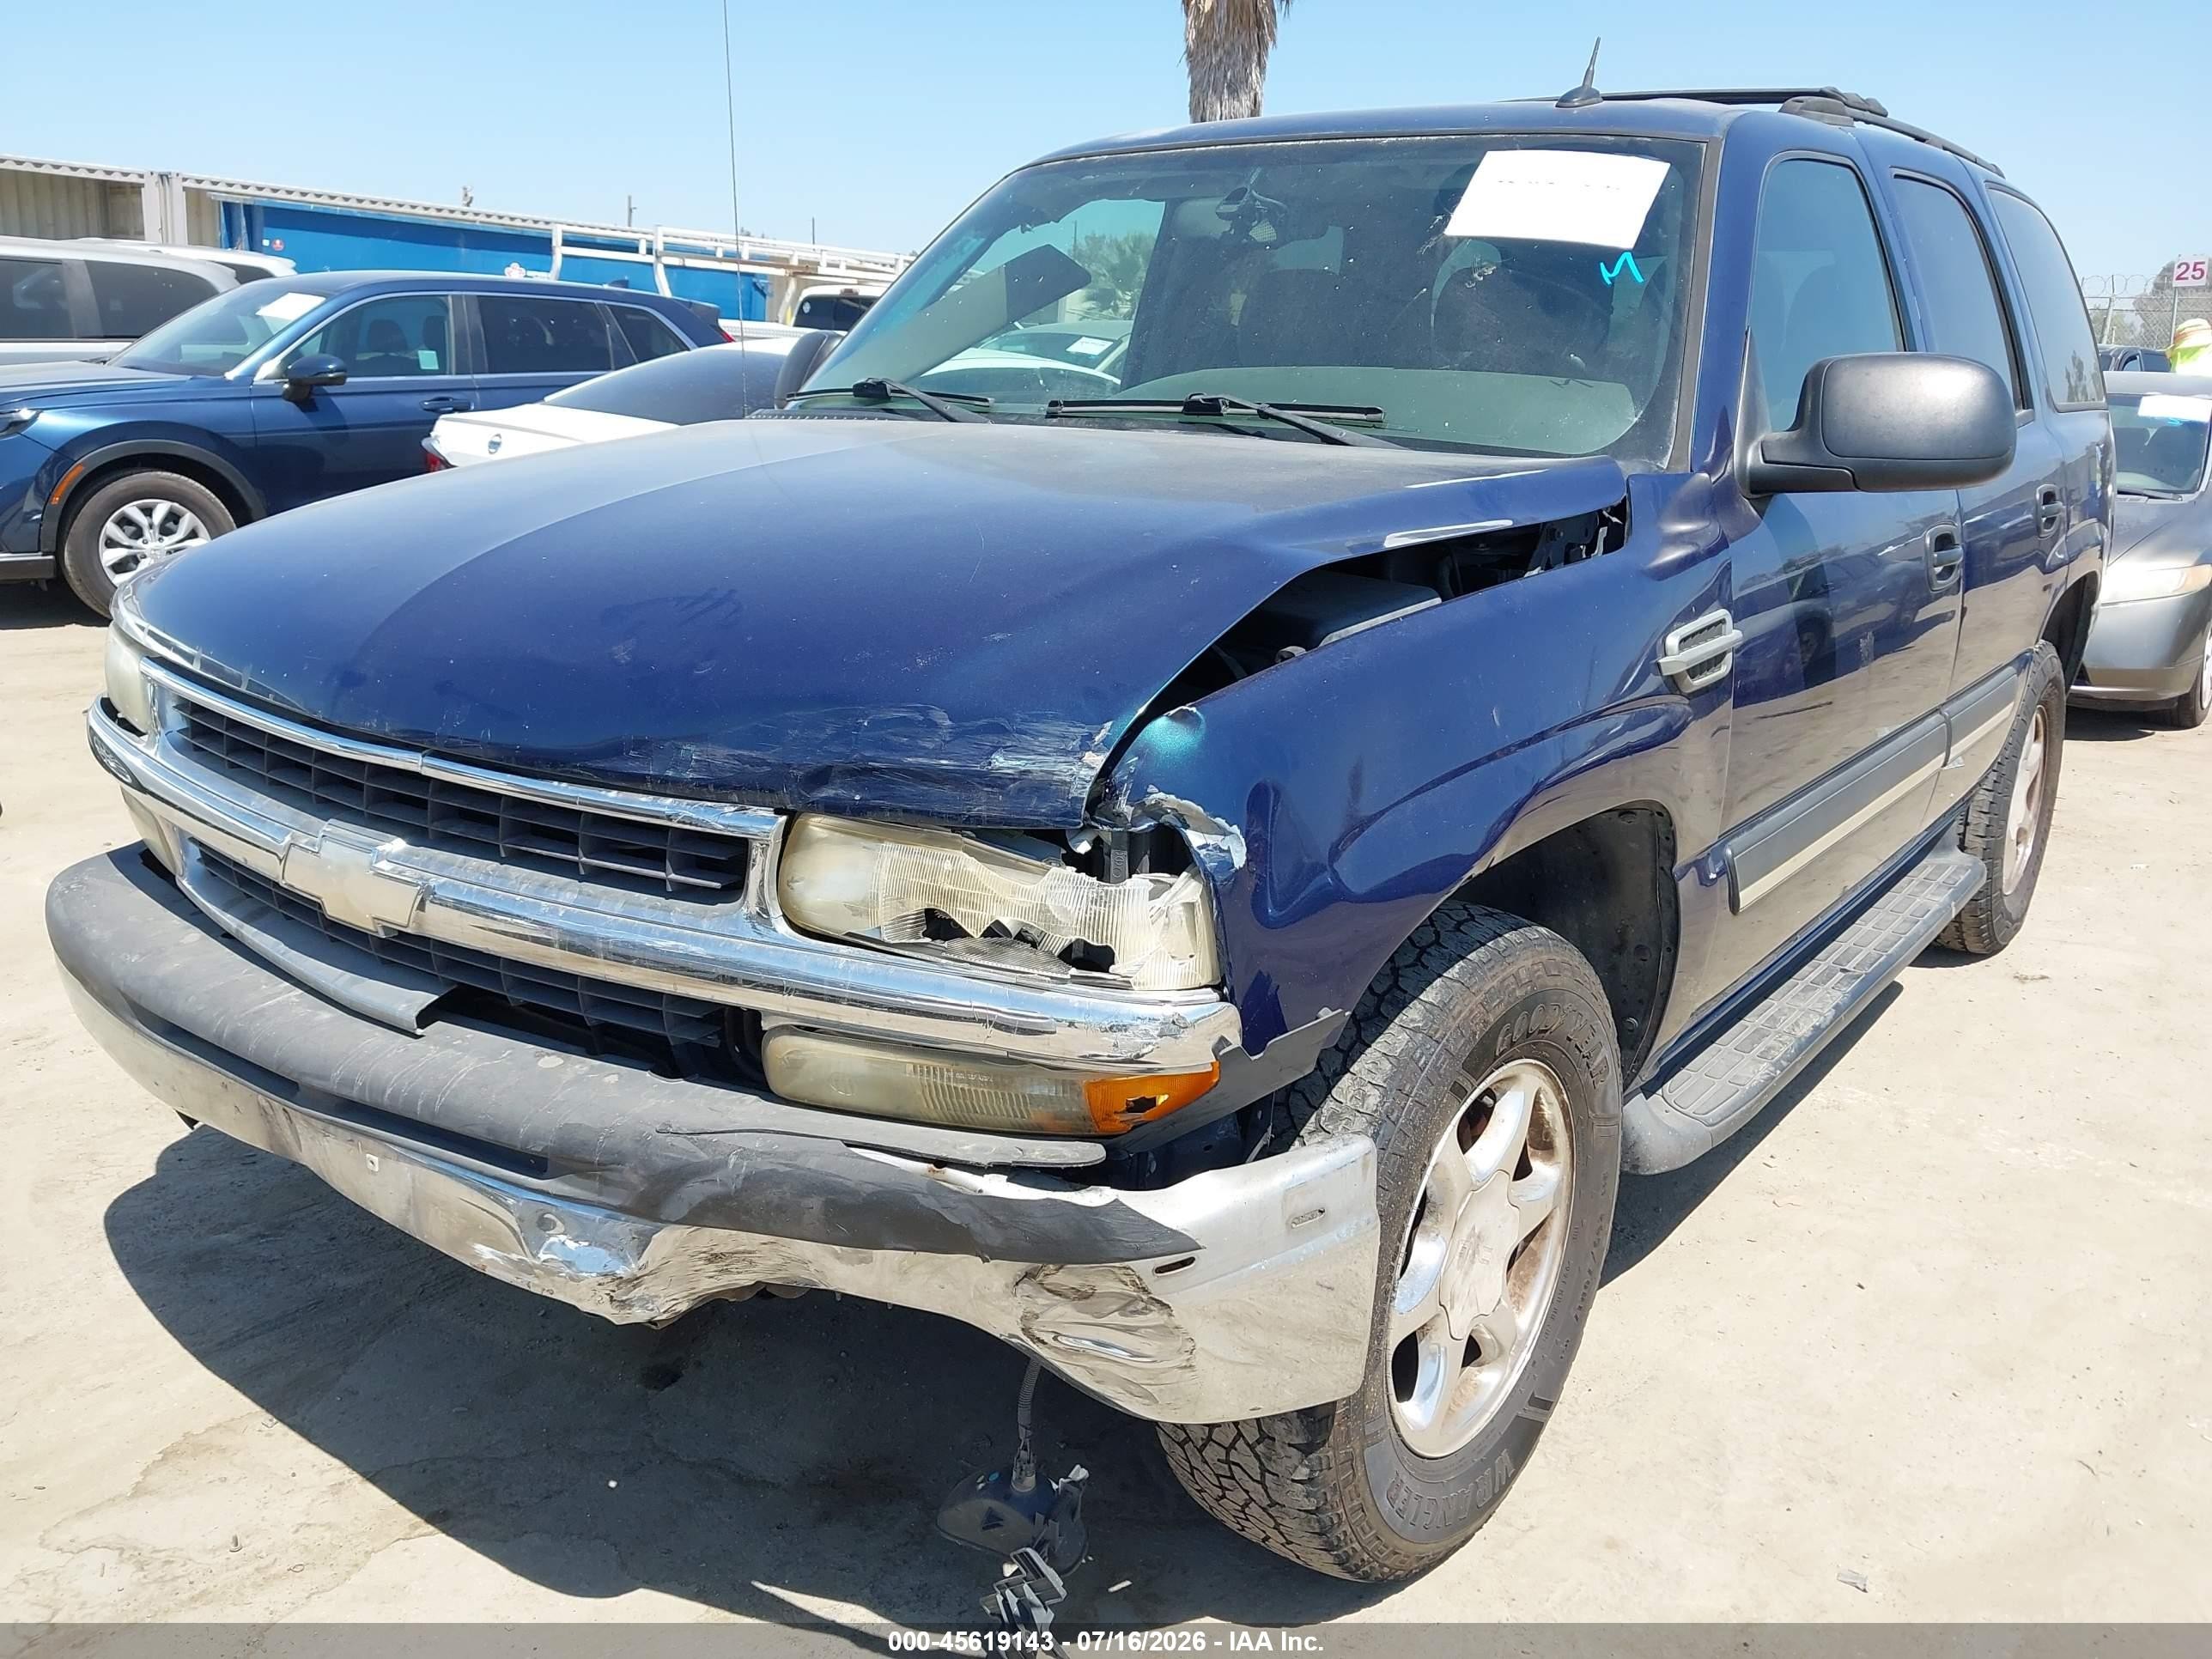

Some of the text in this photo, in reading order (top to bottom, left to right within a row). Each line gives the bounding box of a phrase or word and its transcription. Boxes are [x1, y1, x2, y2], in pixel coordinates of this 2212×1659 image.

[2175, 261, 2206, 281] 25
[1496, 1003, 1609, 1089] GOODYEAR
[1386, 1449, 1516, 1529] WRANGLER
